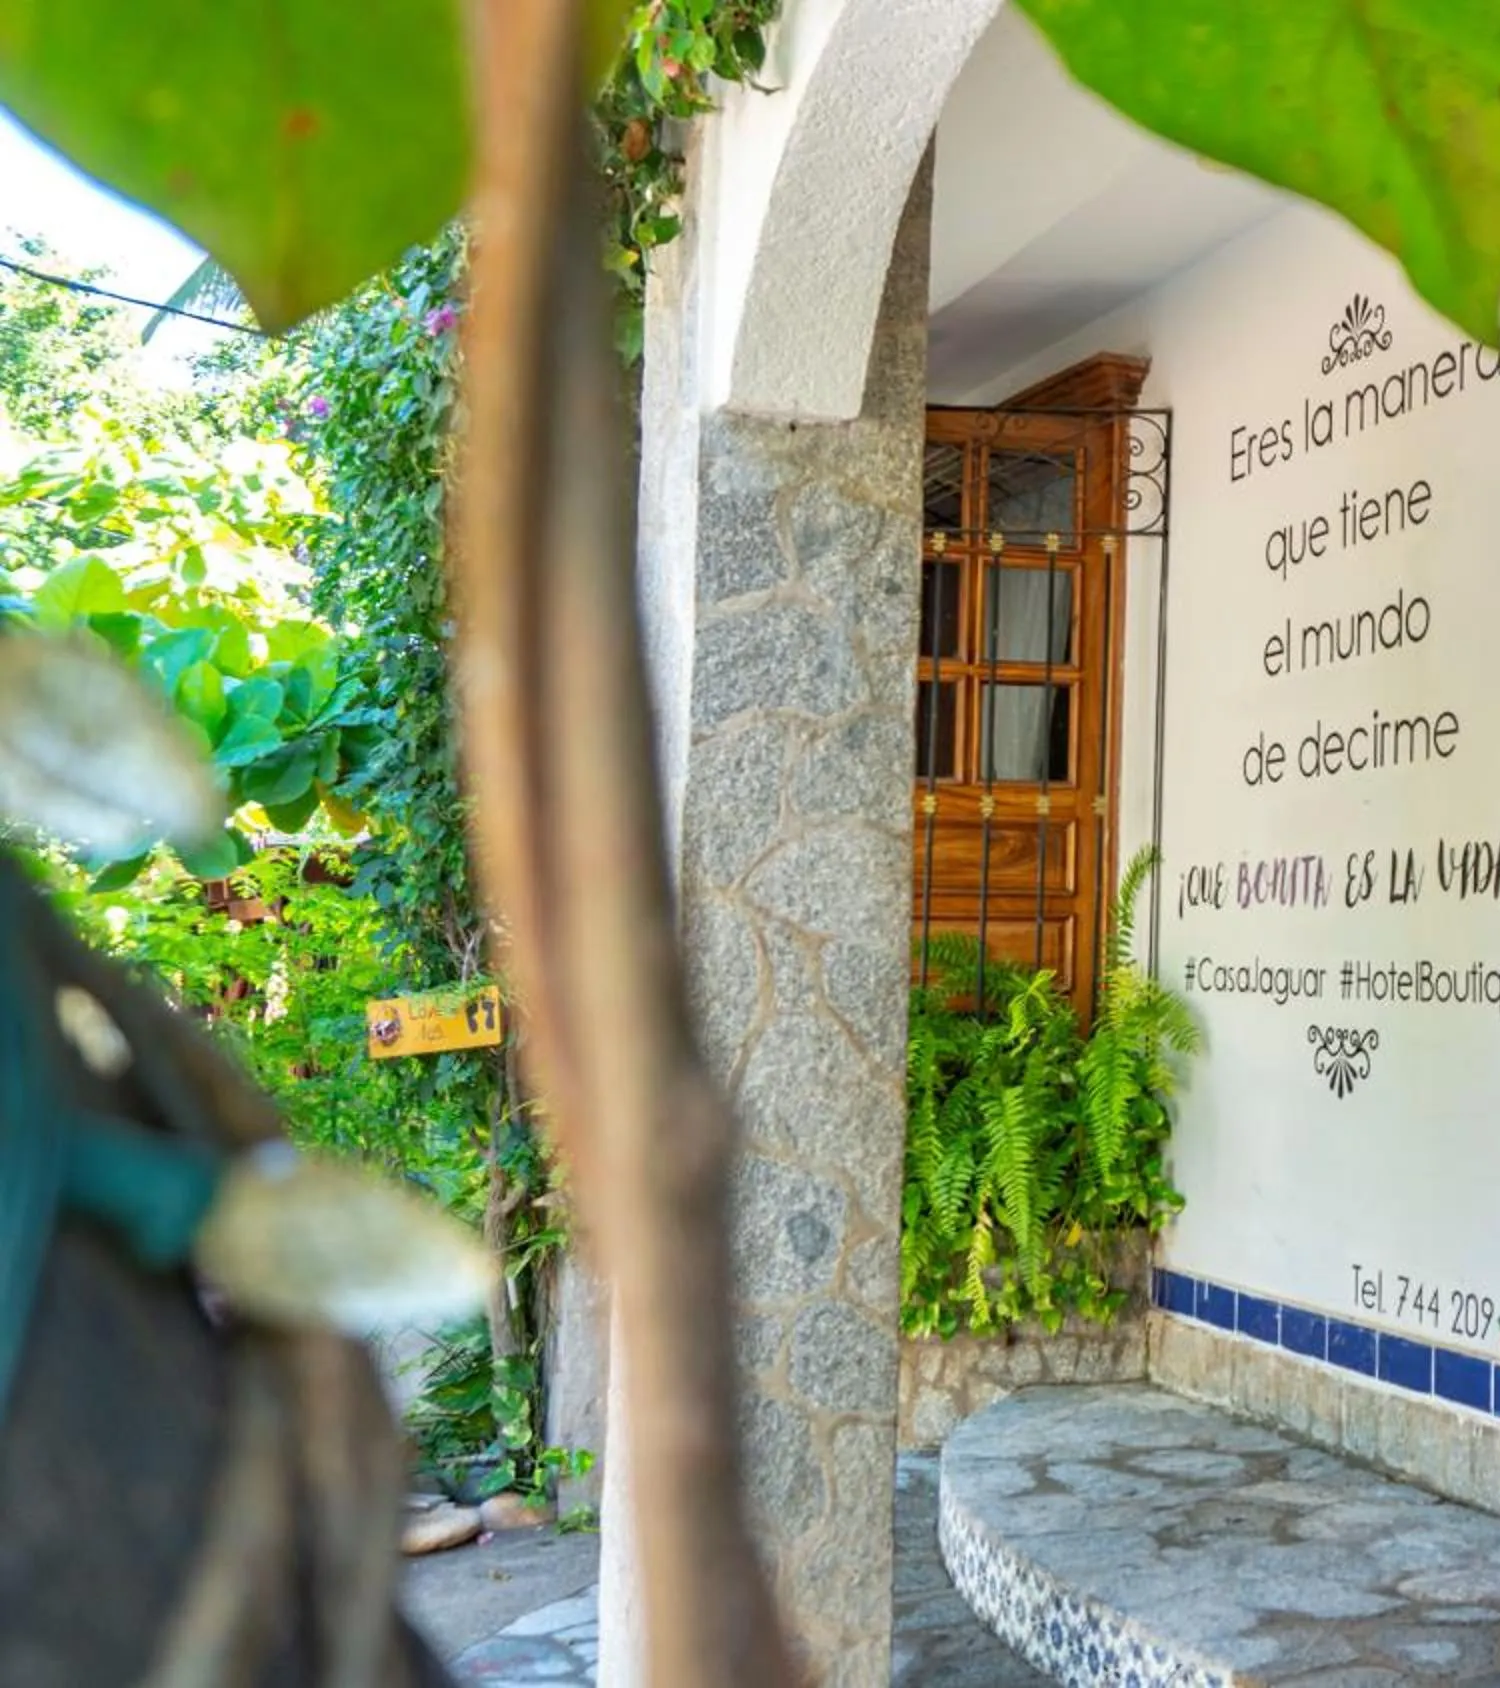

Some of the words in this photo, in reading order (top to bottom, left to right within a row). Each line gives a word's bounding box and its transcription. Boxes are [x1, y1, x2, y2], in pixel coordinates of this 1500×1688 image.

[1231, 419, 1293, 482] Eres
[1304, 398, 1333, 453] la
[1266, 516, 1329, 581] que
[1340, 479, 1431, 549] tiene
[1264, 618, 1291, 676] el
[1301, 588, 1431, 671] mundo
[1243, 731, 1286, 786] de
[1298, 709, 1459, 778] decirme
[1237, 855, 1332, 910] BONITA
[1345, 849, 1378, 908] ES
[1390, 848, 1424, 904] LA
[1185, 954, 1326, 1005] #CasaJaguar
[1397, 1275, 1440, 1329] 744
[1451, 1290, 1494, 1340] 209
